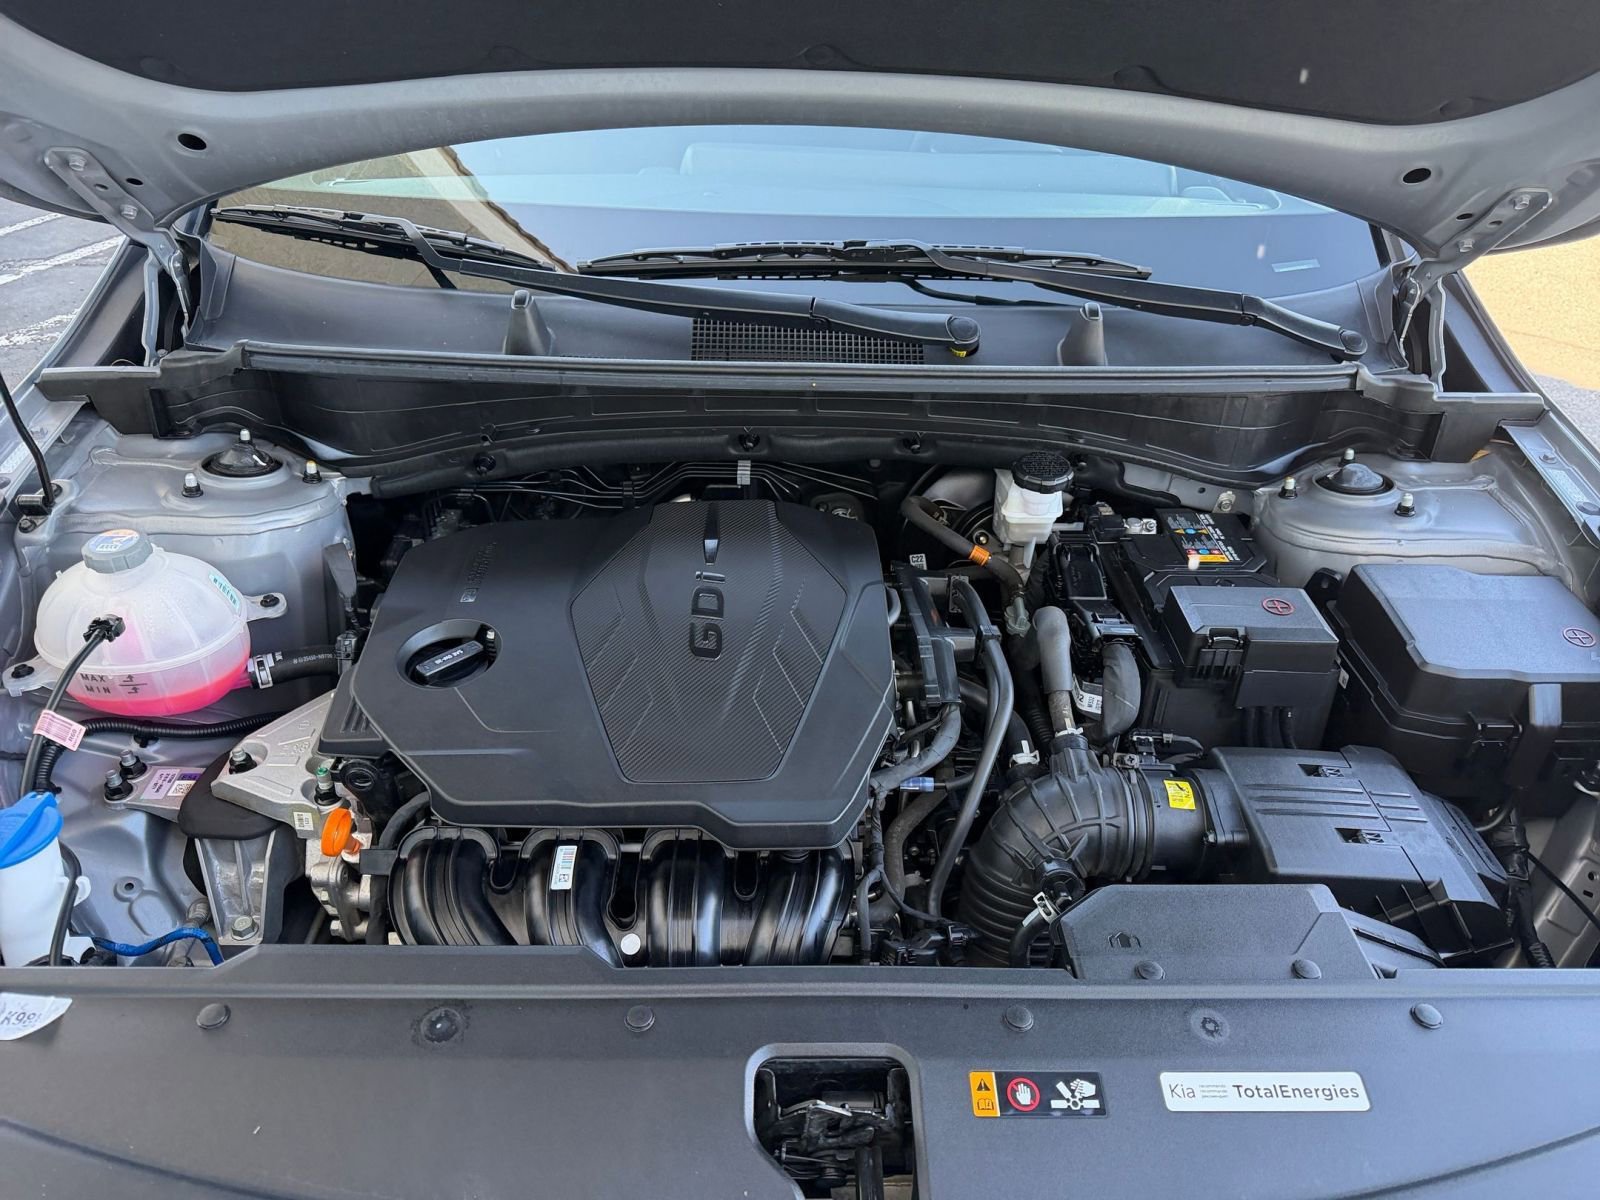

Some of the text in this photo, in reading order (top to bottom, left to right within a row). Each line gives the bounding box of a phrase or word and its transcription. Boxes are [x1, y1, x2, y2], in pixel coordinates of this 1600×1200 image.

[689, 571, 726, 660] GDi
[80, 672, 105, 682] MAX
[85, 684, 111, 694] MIN
[1169, 1083, 1360, 1101] Kia TotalEnergies
